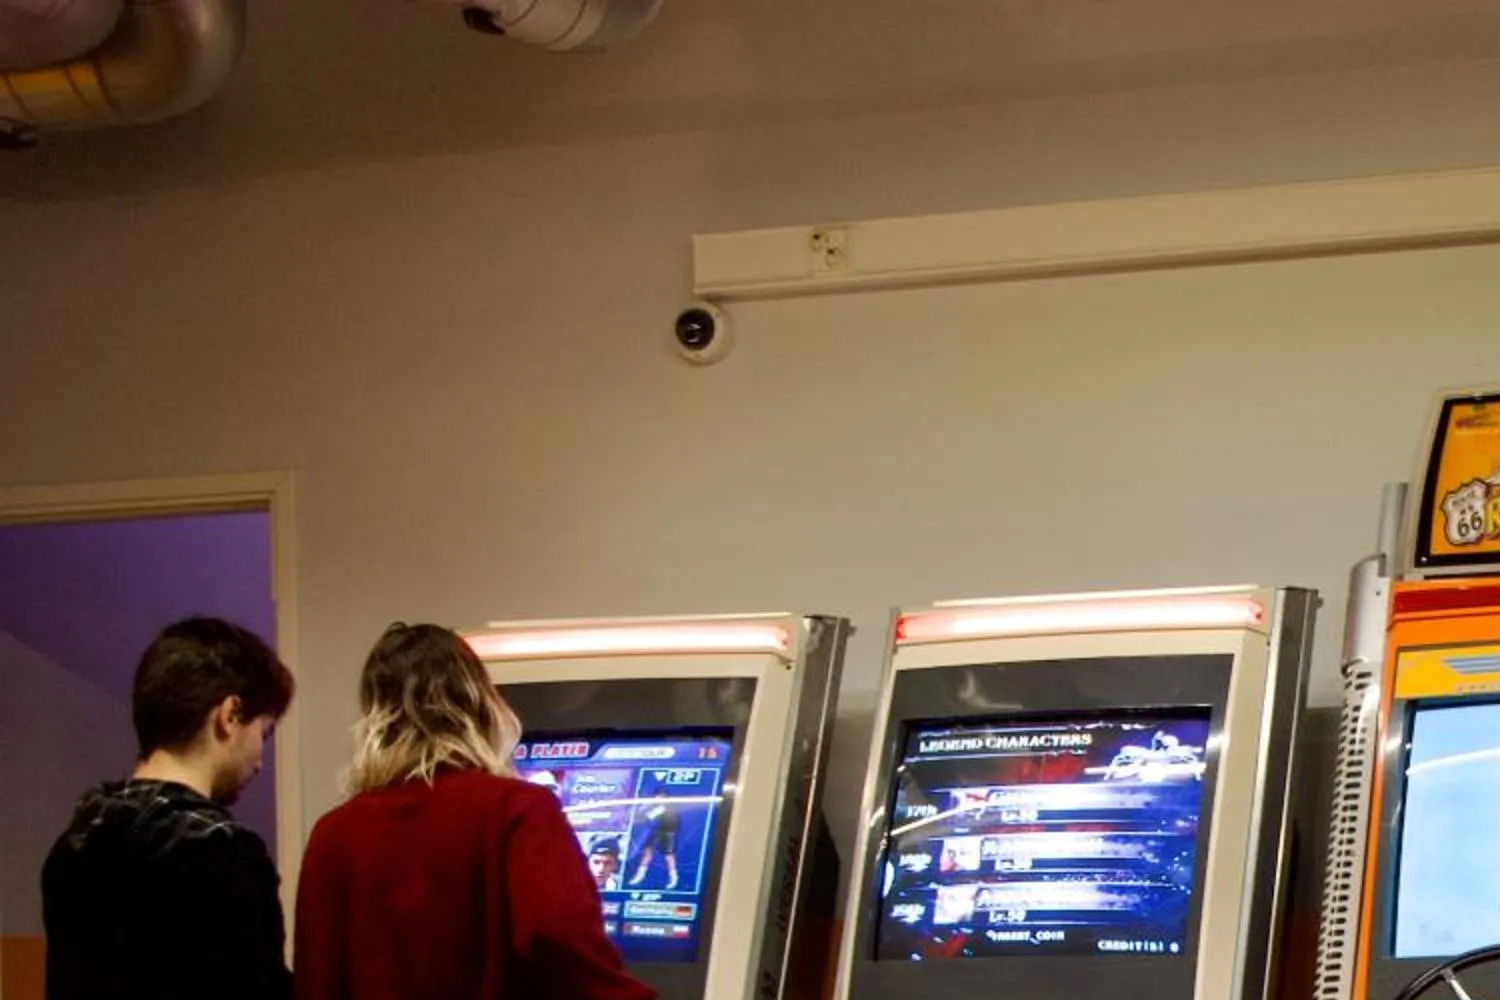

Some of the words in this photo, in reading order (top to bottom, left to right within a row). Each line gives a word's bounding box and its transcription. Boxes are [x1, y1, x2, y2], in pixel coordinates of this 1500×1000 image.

[1457, 512, 1484, 538] 66
[919, 737, 984, 753] LEGEND
[986, 733, 1093, 750] CHARACTERS
